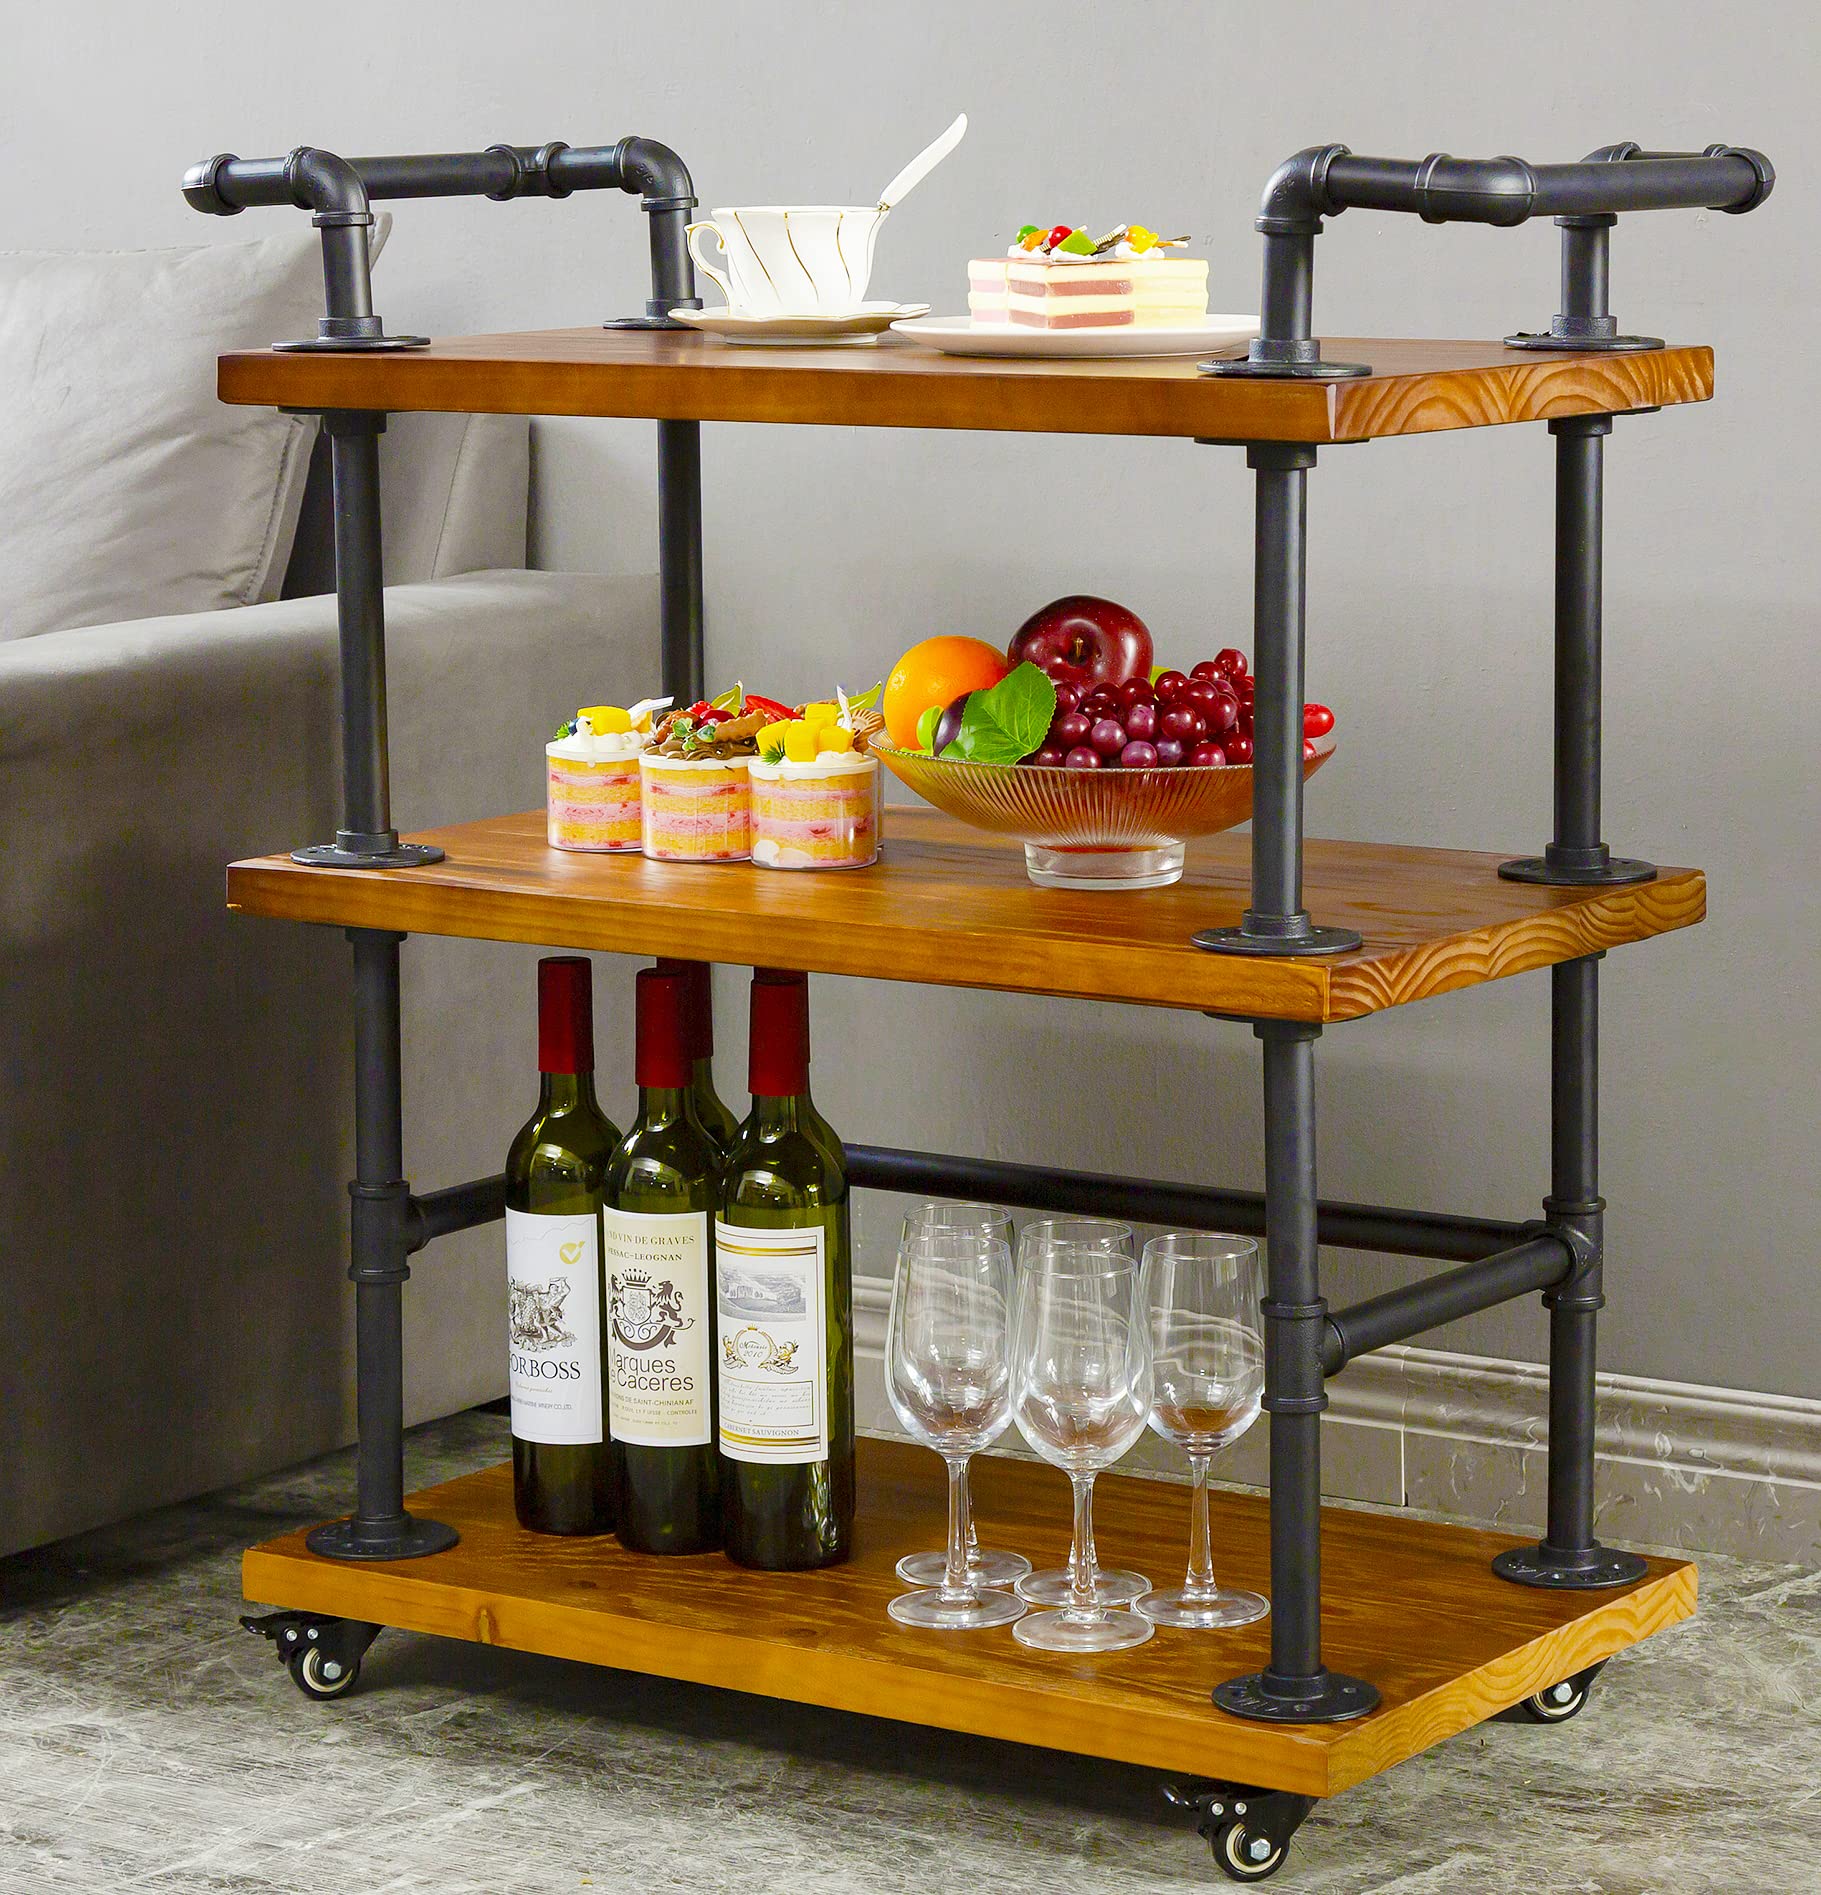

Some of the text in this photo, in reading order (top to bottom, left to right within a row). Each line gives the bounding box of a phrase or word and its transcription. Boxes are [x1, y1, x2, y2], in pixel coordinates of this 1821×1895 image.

[619, 1232, 633, 1243] VIN
[634, 1235, 648, 1245] DE
[650, 1235, 695, 1246] GRAVES
[510, 1351, 581, 1380] ORBOSS
[617, 1367, 694, 1392] Caceres
[752, 1429, 799, 1437] SAUVIGNON
